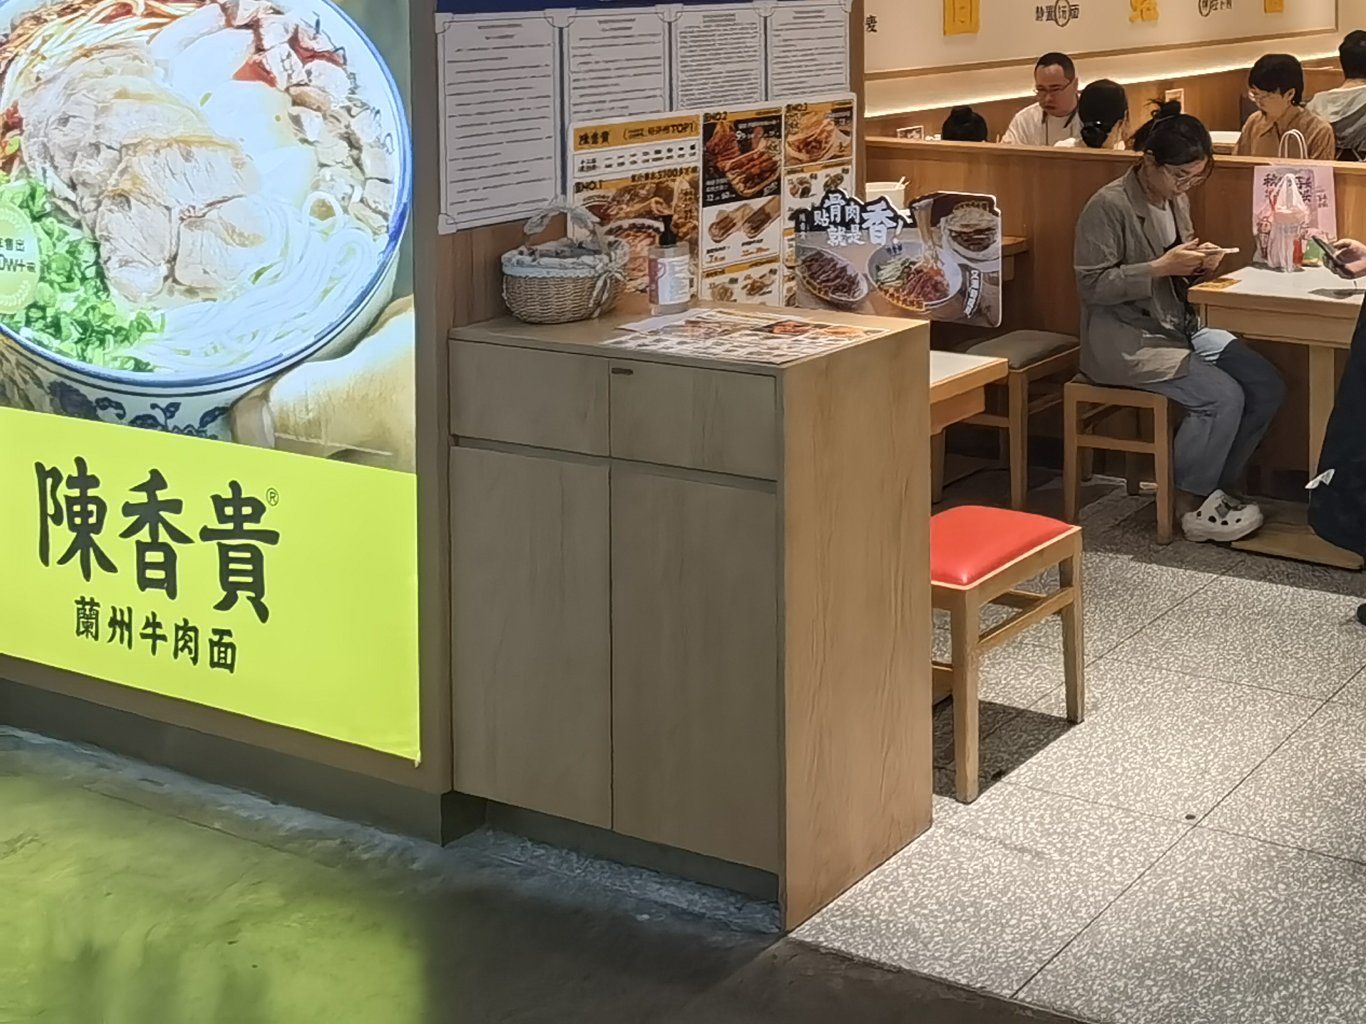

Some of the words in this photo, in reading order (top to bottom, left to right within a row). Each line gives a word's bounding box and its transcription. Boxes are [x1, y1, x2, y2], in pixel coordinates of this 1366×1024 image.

[34, 456, 280, 623] 陳香貴
[74, 596, 238, 674] 蘭州牛肉面
